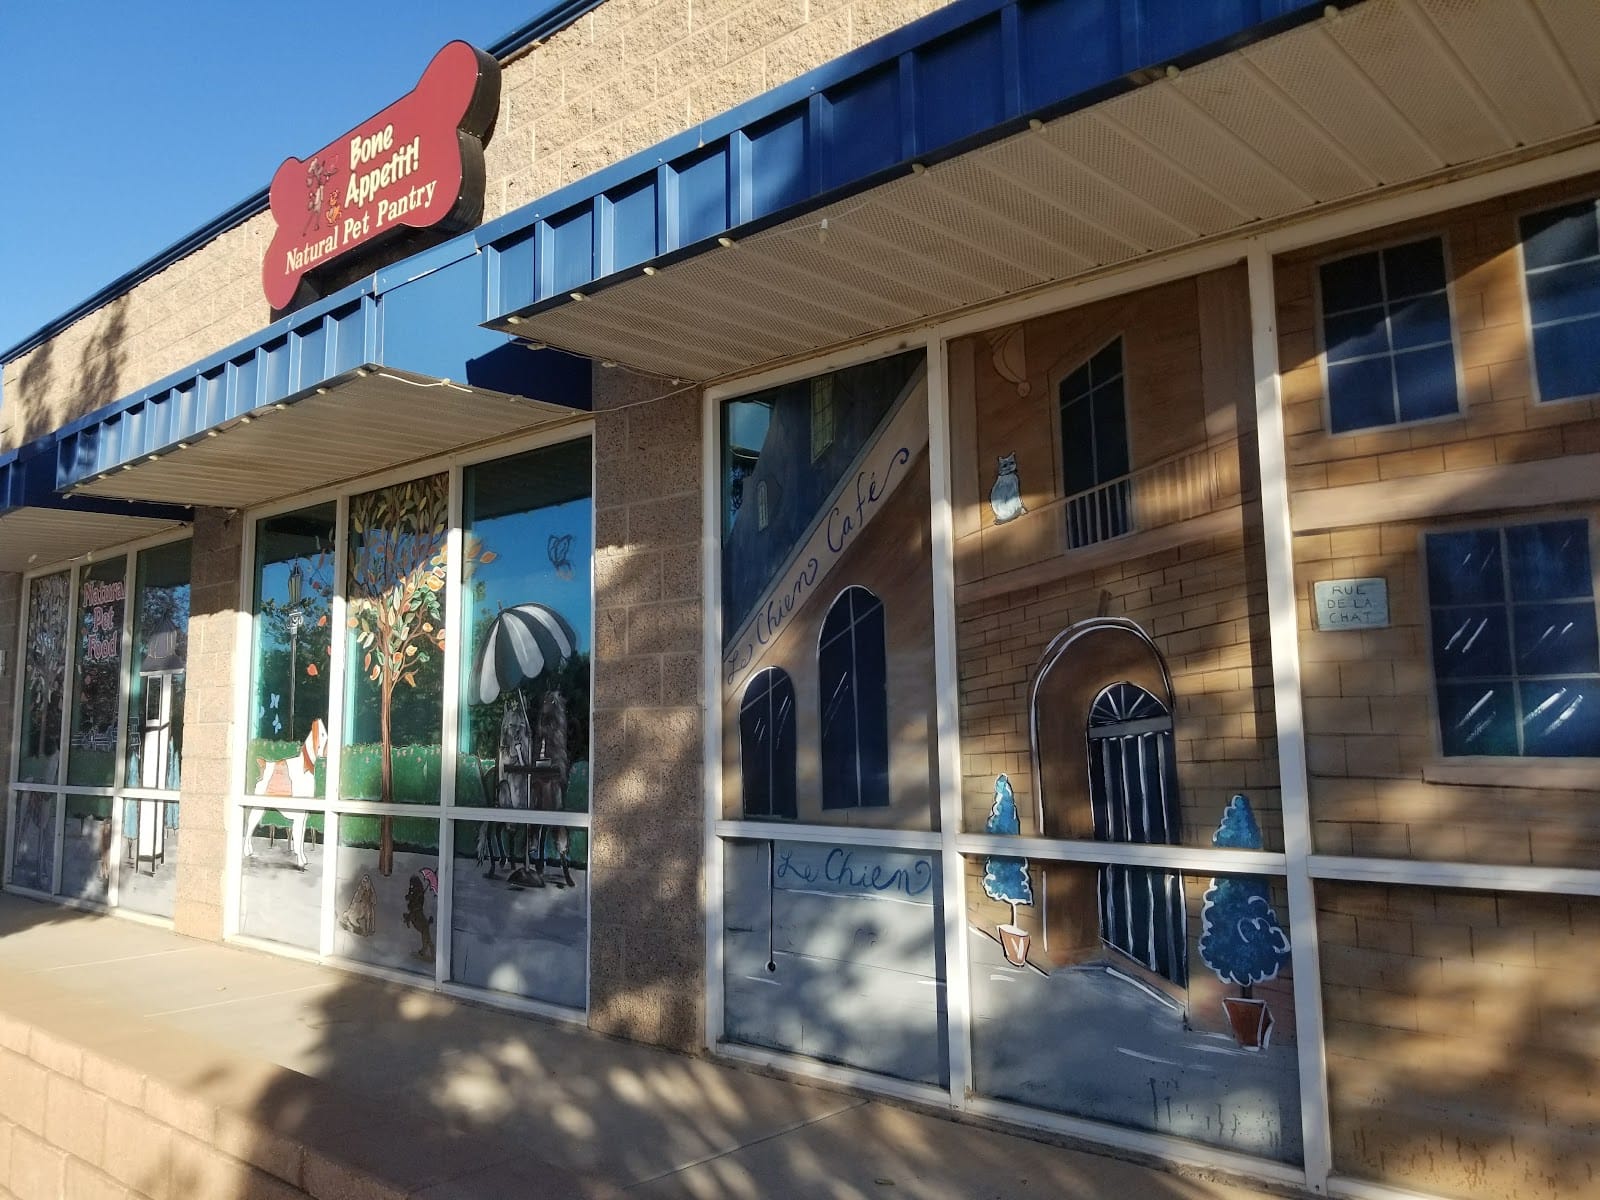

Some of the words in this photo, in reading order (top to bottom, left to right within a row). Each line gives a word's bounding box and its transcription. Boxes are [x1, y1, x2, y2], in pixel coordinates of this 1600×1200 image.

[350, 124, 394, 170] Bone
[345, 136, 420, 207] Appetit!
[284, 226, 338, 275] Natural
[342, 212, 370, 245] Pet
[376, 180, 437, 228] Pantry
[757, 557, 818, 645] Chien
[827, 447, 909, 553] Café
[82, 578, 127, 607] Natural
[1327, 599, 1345, 609] DE
[1353, 598, 1373, 609] LA
[1332, 585, 1366, 595] RUE
[92, 606, 114, 632] Pet
[1328, 611, 1370, 623] CHAT
[87, 631, 118, 660] Food
[778, 852, 818, 883] Le
[825, 848, 932, 895] Chien
